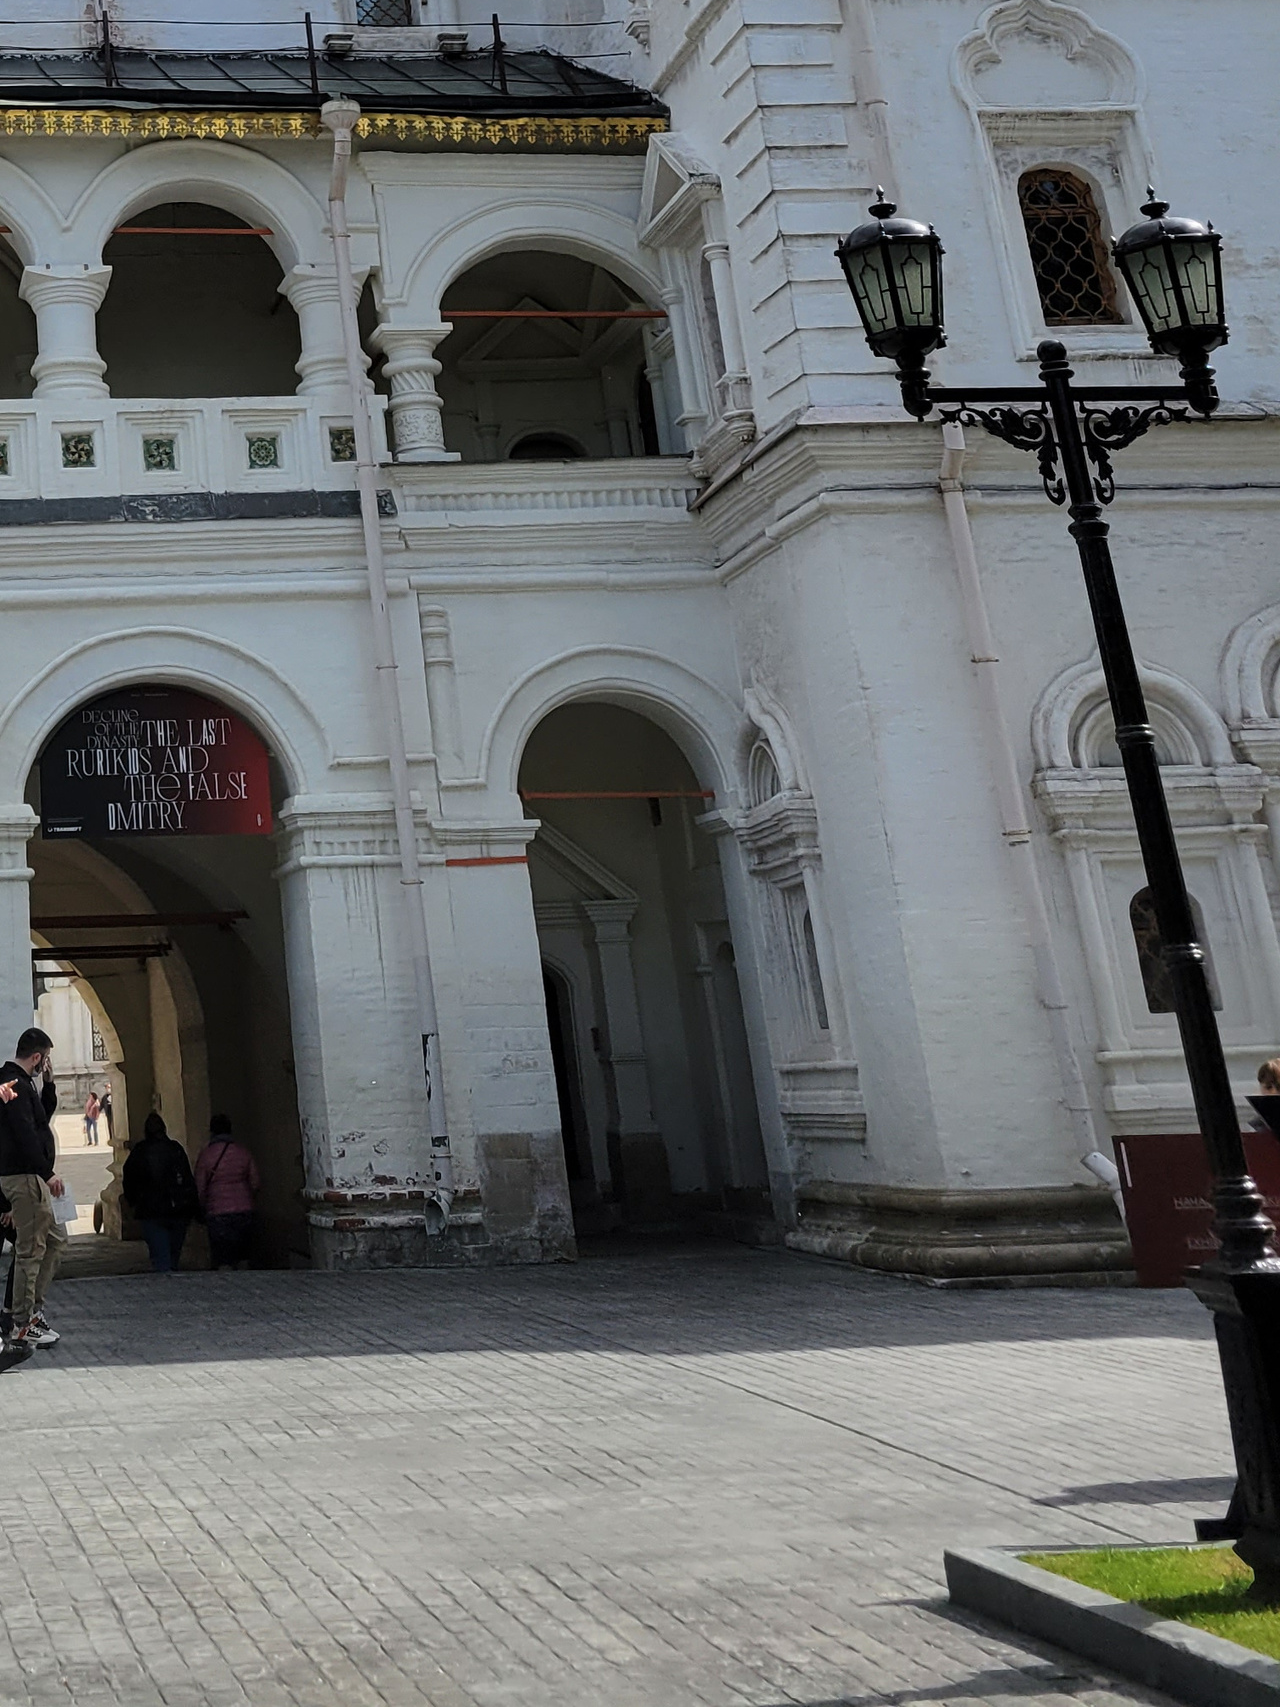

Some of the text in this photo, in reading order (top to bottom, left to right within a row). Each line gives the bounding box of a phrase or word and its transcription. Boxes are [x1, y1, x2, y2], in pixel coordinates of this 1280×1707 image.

[95, 723, 111, 735] OF
[141, 718, 232, 747] THE LAST
[66, 746, 209, 779] RURIKIDS AND
[189, 771, 248, 800] FALSE
